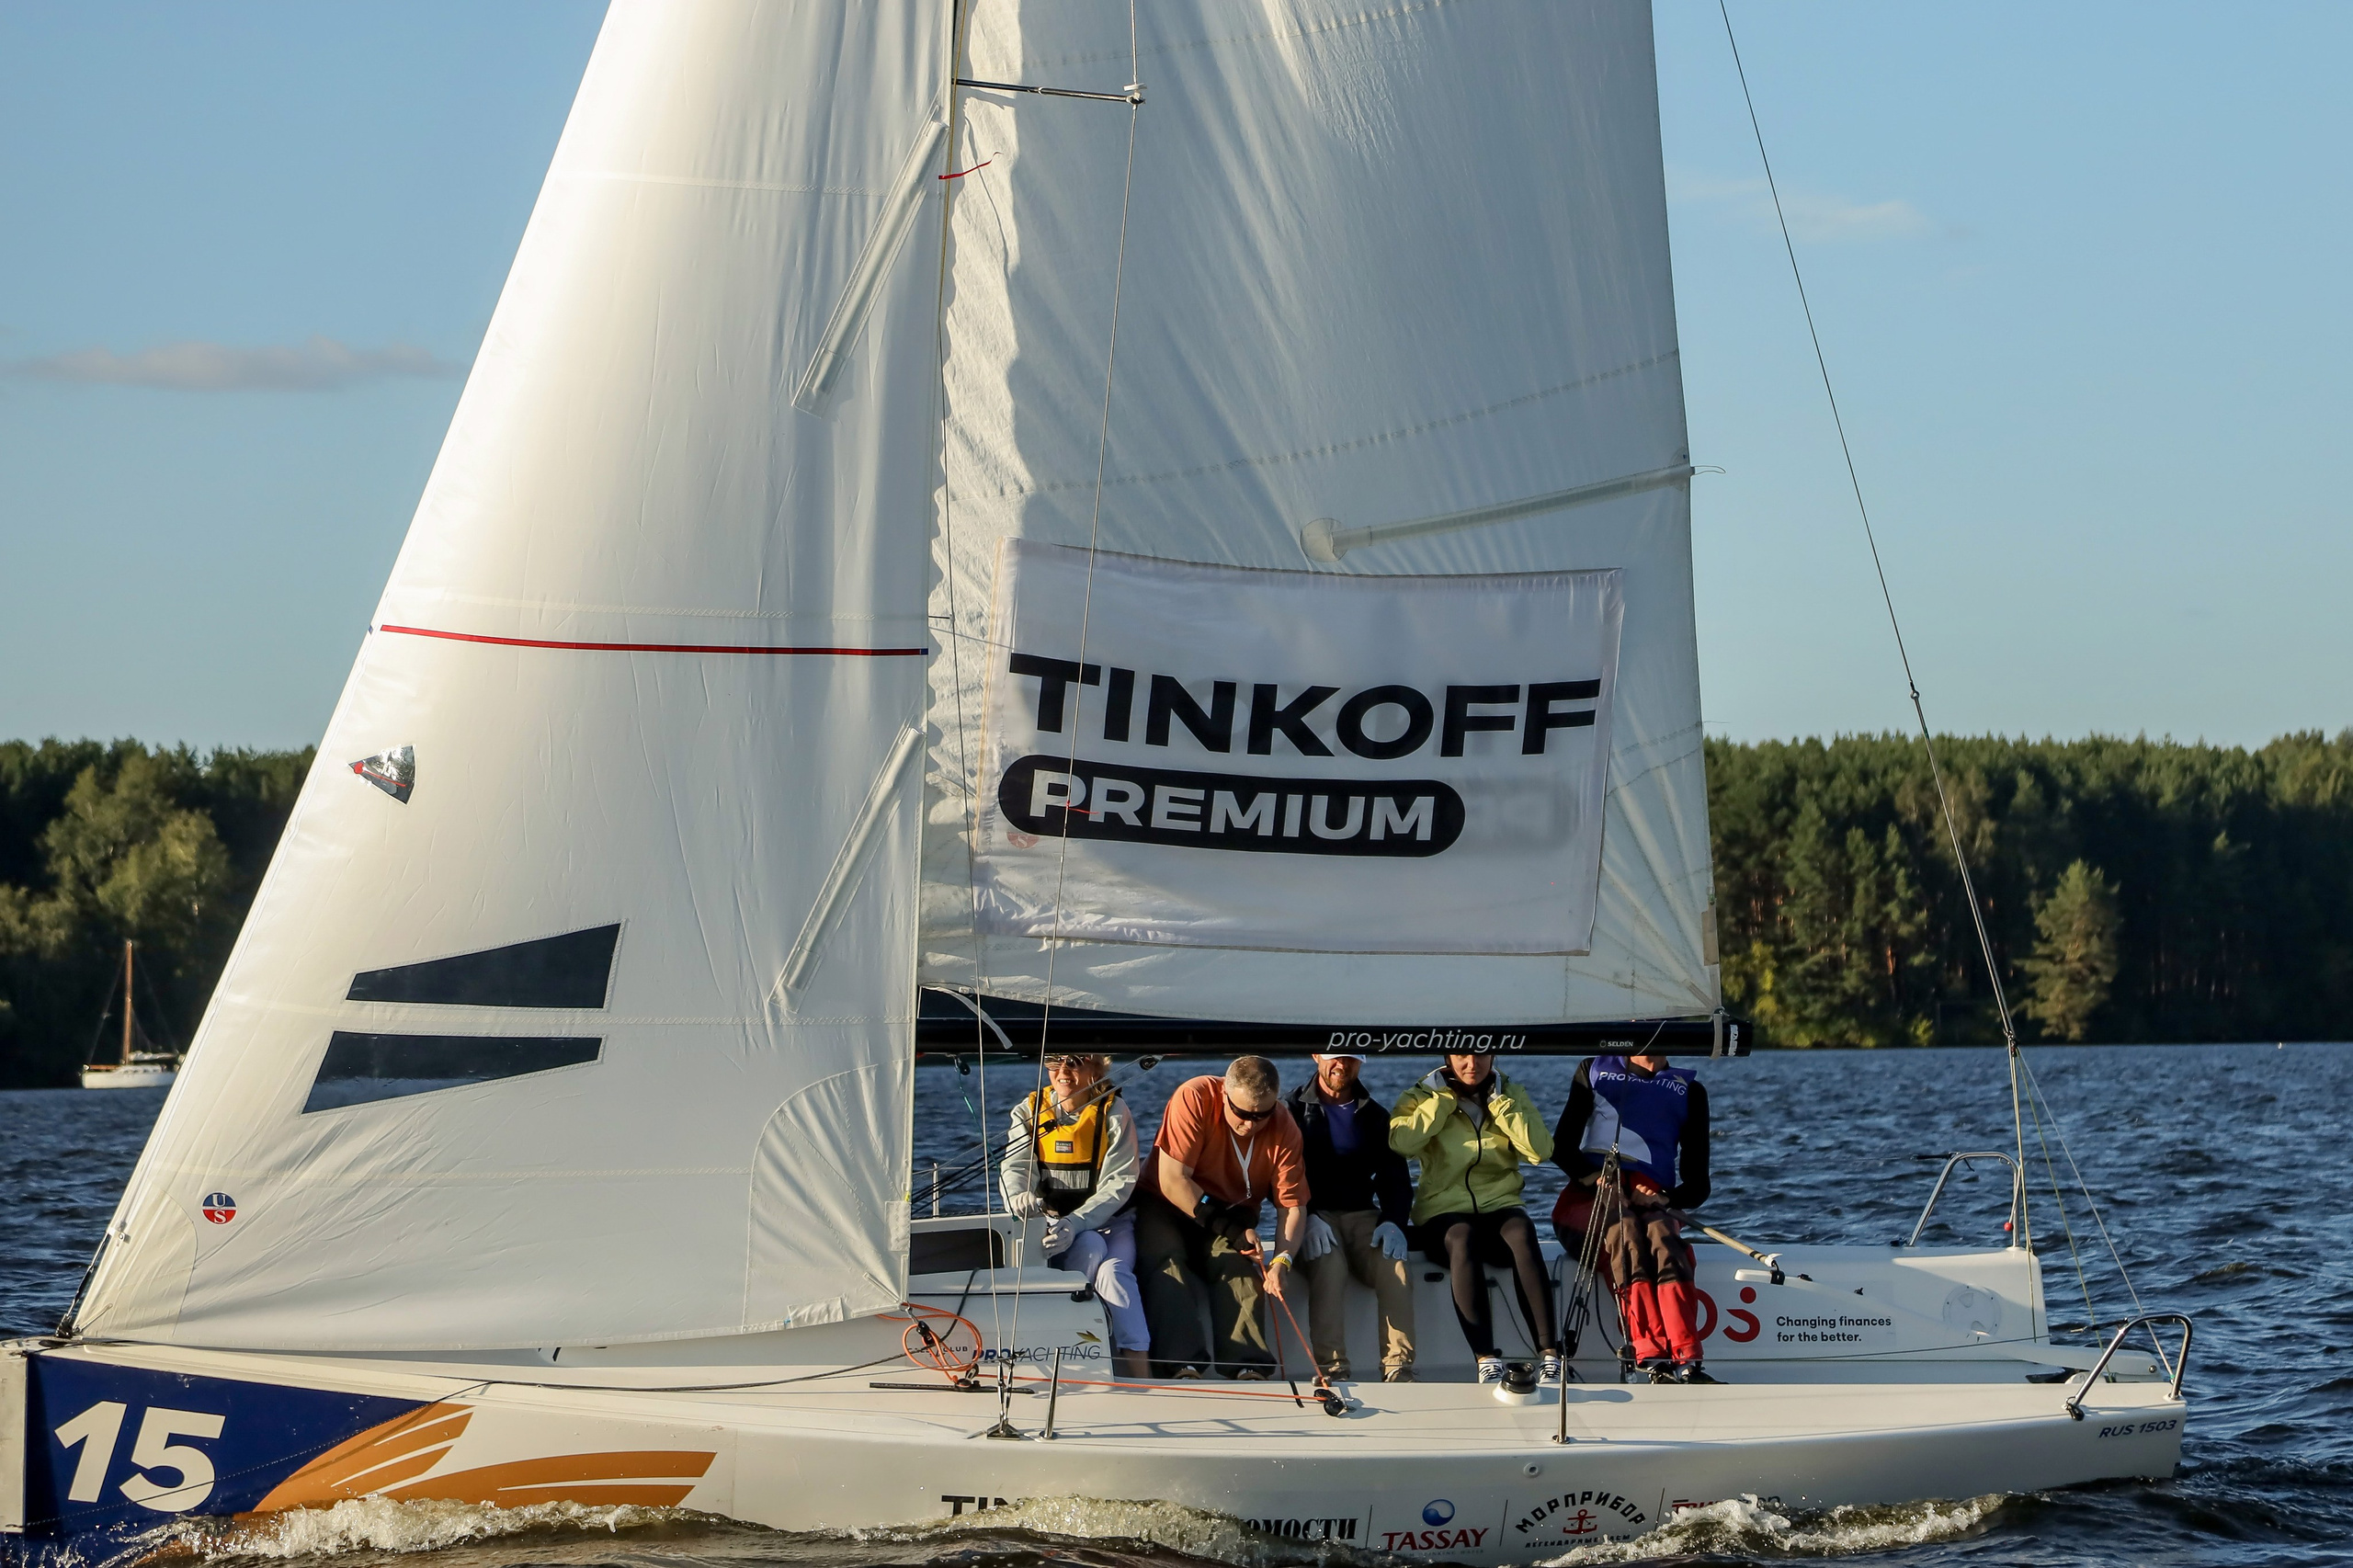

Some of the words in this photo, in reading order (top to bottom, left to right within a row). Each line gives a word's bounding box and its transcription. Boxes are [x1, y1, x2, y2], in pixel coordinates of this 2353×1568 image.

[1009, 653, 1601, 761] TINKOFF
[1029, 768, 1436, 842] PREMIUM
[1326, 1028, 1527, 1053] pro-yachting.ru
[1776, 1315, 1836, 1329] Changing
[1838, 1315, 1893, 1327] finances
[1777, 1331, 1795, 1343] for
[1798, 1331, 1818, 1343] the
[1821, 1331, 1862, 1343] better.
[2098, 1424, 2135, 1438] RUS
[2139, 1419, 2177, 1434] 1503
[54, 1400, 226, 1513] 15
[1515, 1491, 1646, 1533] МОРПРИБОР
[1381, 1528, 1490, 1551] TASSAY
